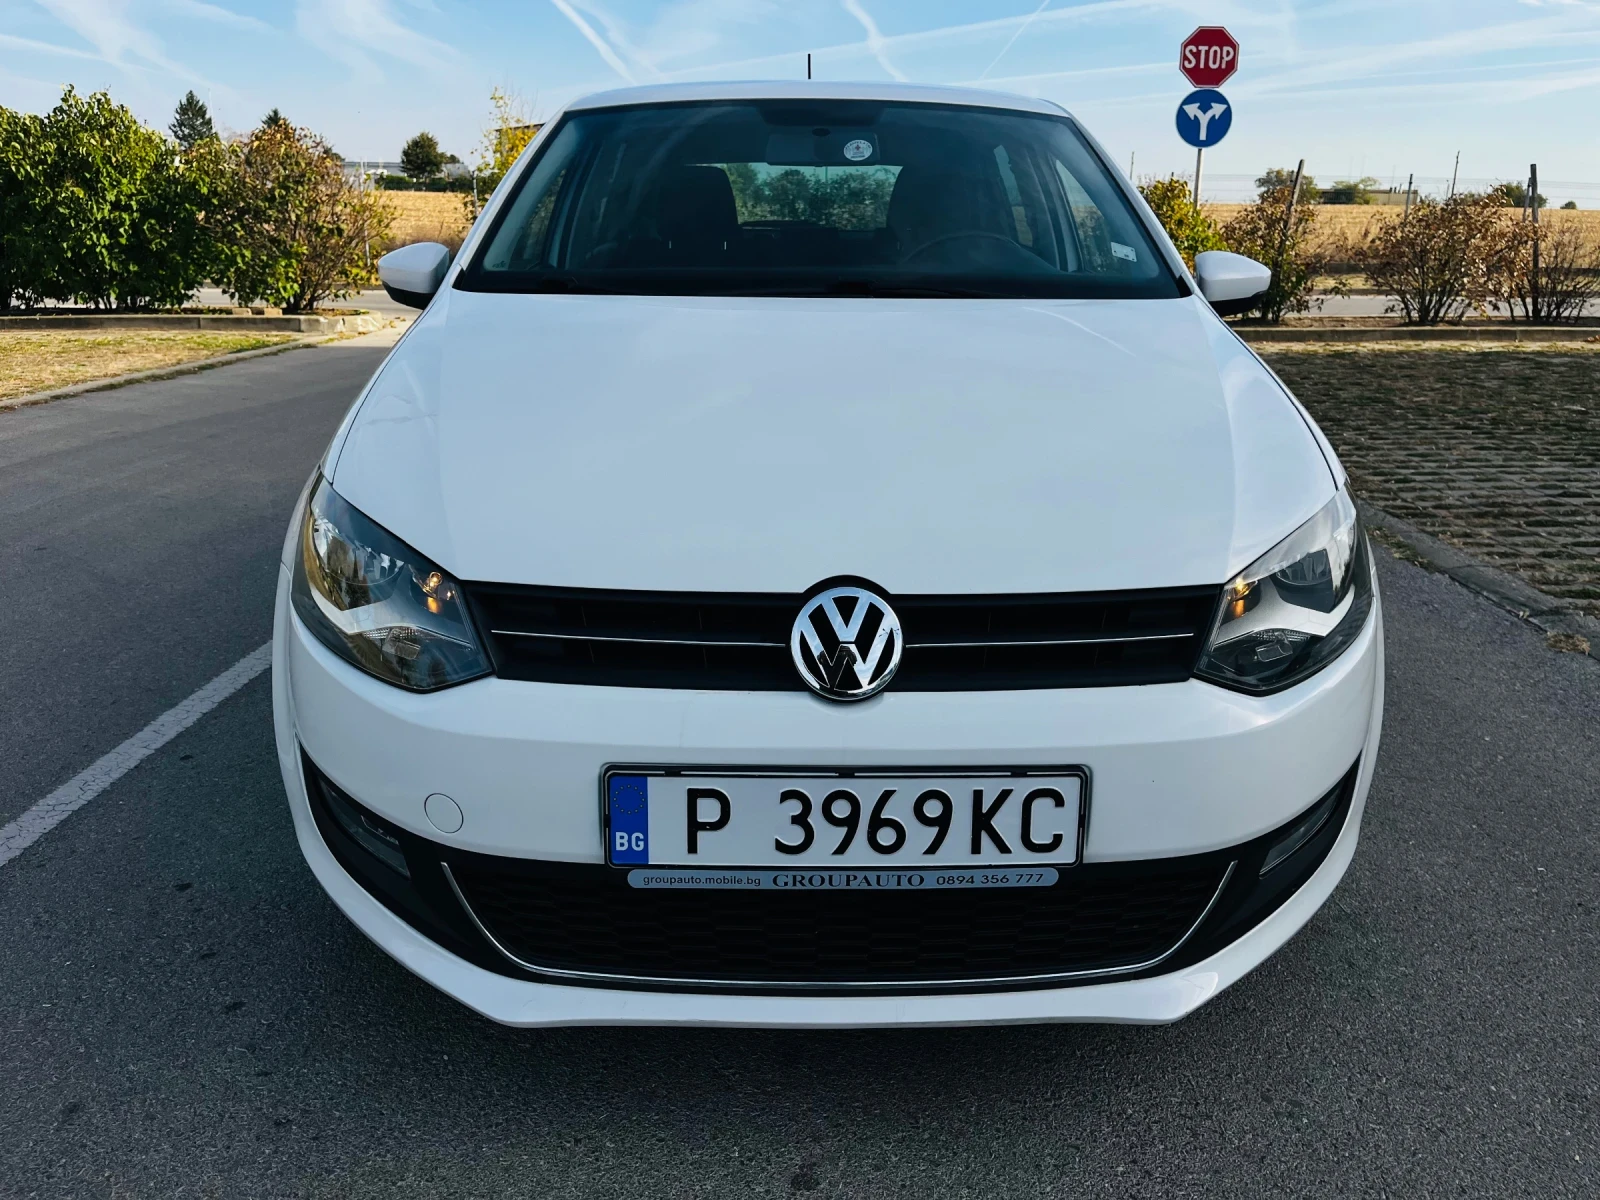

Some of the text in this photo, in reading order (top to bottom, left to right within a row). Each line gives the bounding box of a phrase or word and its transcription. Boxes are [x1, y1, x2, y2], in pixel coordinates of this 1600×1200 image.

[1184, 45, 1235, 69] STOP
[686, 787, 731, 855] P
[774, 788, 954, 855] 3969
[615, 831, 645, 851] BG
[643, 873, 1044, 888] groupauto.mobile.bg GROUPAUTO 0894 356 777
